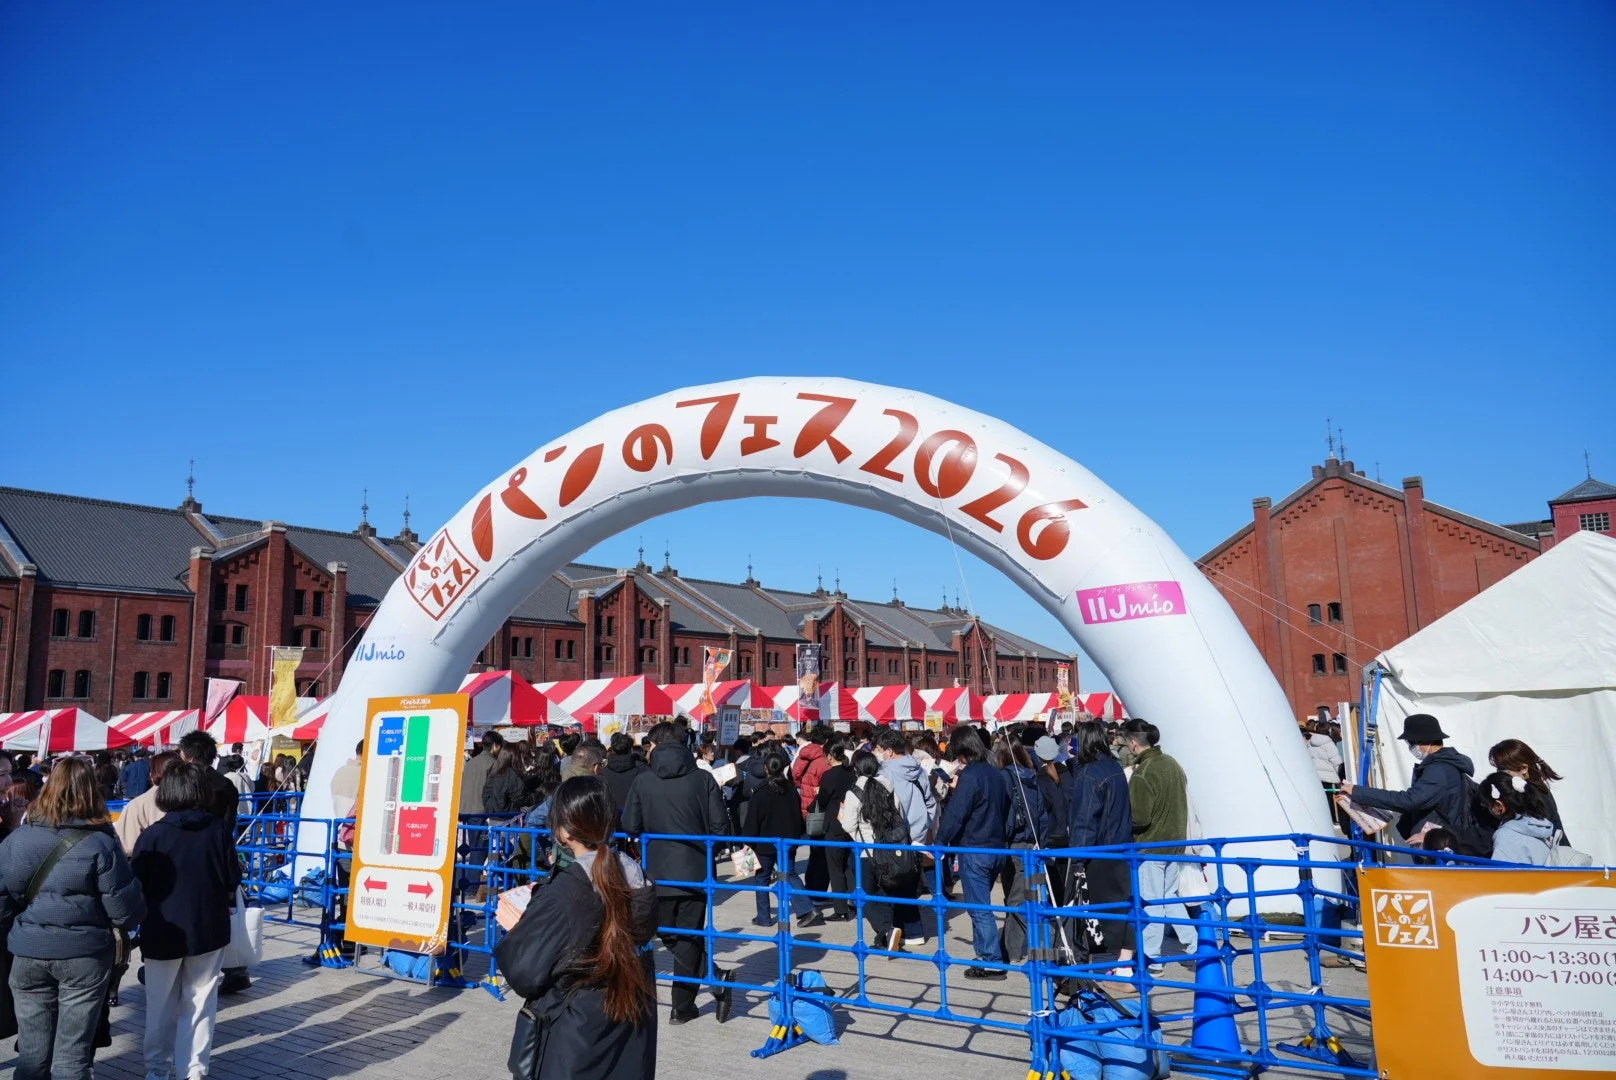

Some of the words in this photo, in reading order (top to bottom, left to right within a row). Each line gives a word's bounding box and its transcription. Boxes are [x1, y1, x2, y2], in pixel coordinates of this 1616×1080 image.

[409, 536, 446, 589] パン
[421, 558, 471, 607] フェス
[1087, 593, 1174, 621] IIJmio
[355, 643, 405, 661] IIJmio
[1376, 893, 1429, 915] パン
[1398, 914, 1411, 925] の
[1378, 922, 1434, 945] フェス
[1486, 986, 1522, 995] 注意事項
